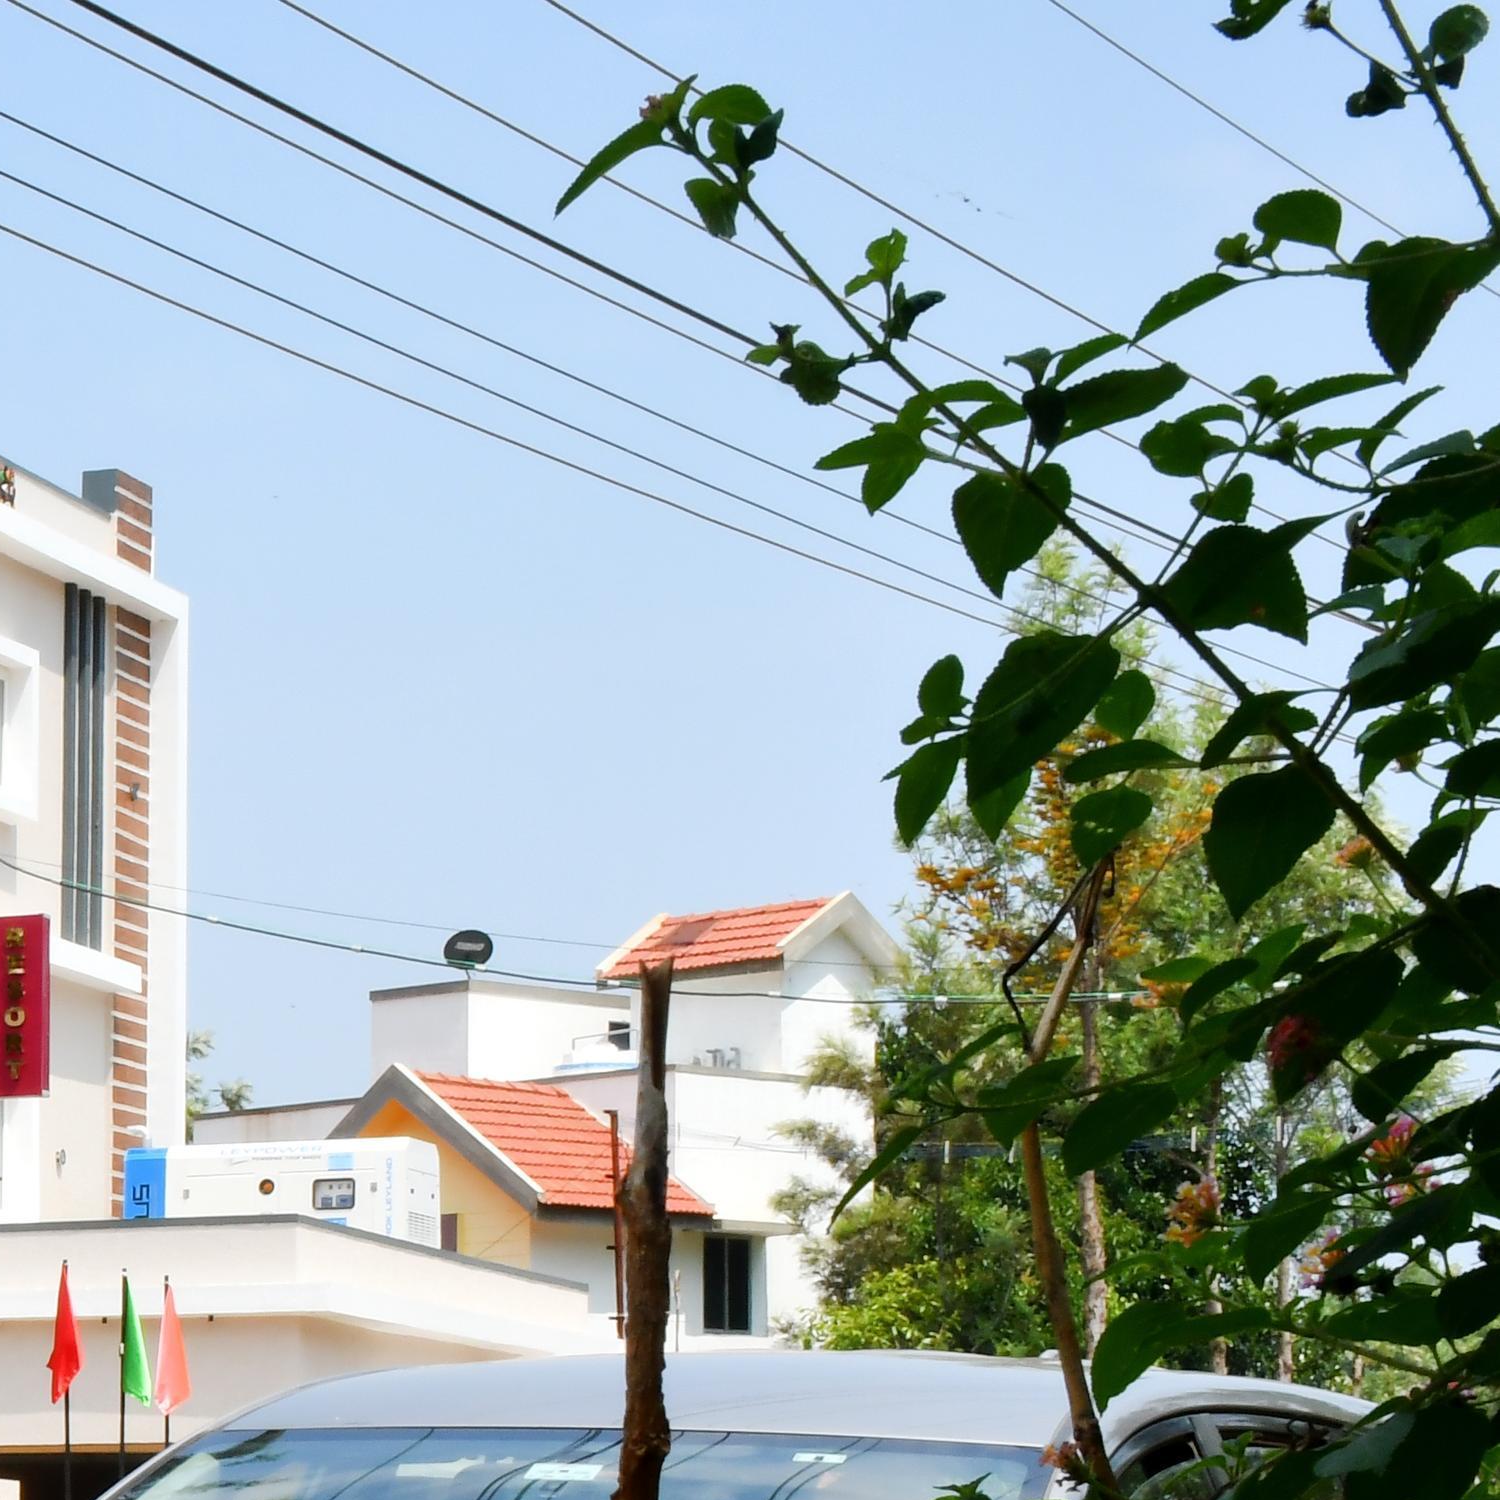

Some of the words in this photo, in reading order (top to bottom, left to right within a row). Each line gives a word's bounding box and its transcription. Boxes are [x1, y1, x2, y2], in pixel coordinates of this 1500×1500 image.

[4, 927, 26, 1081] RESORT
[220, 1145, 322, 1156] LEYPOWER
[384, 1156, 393, 1212] LEYLAND
